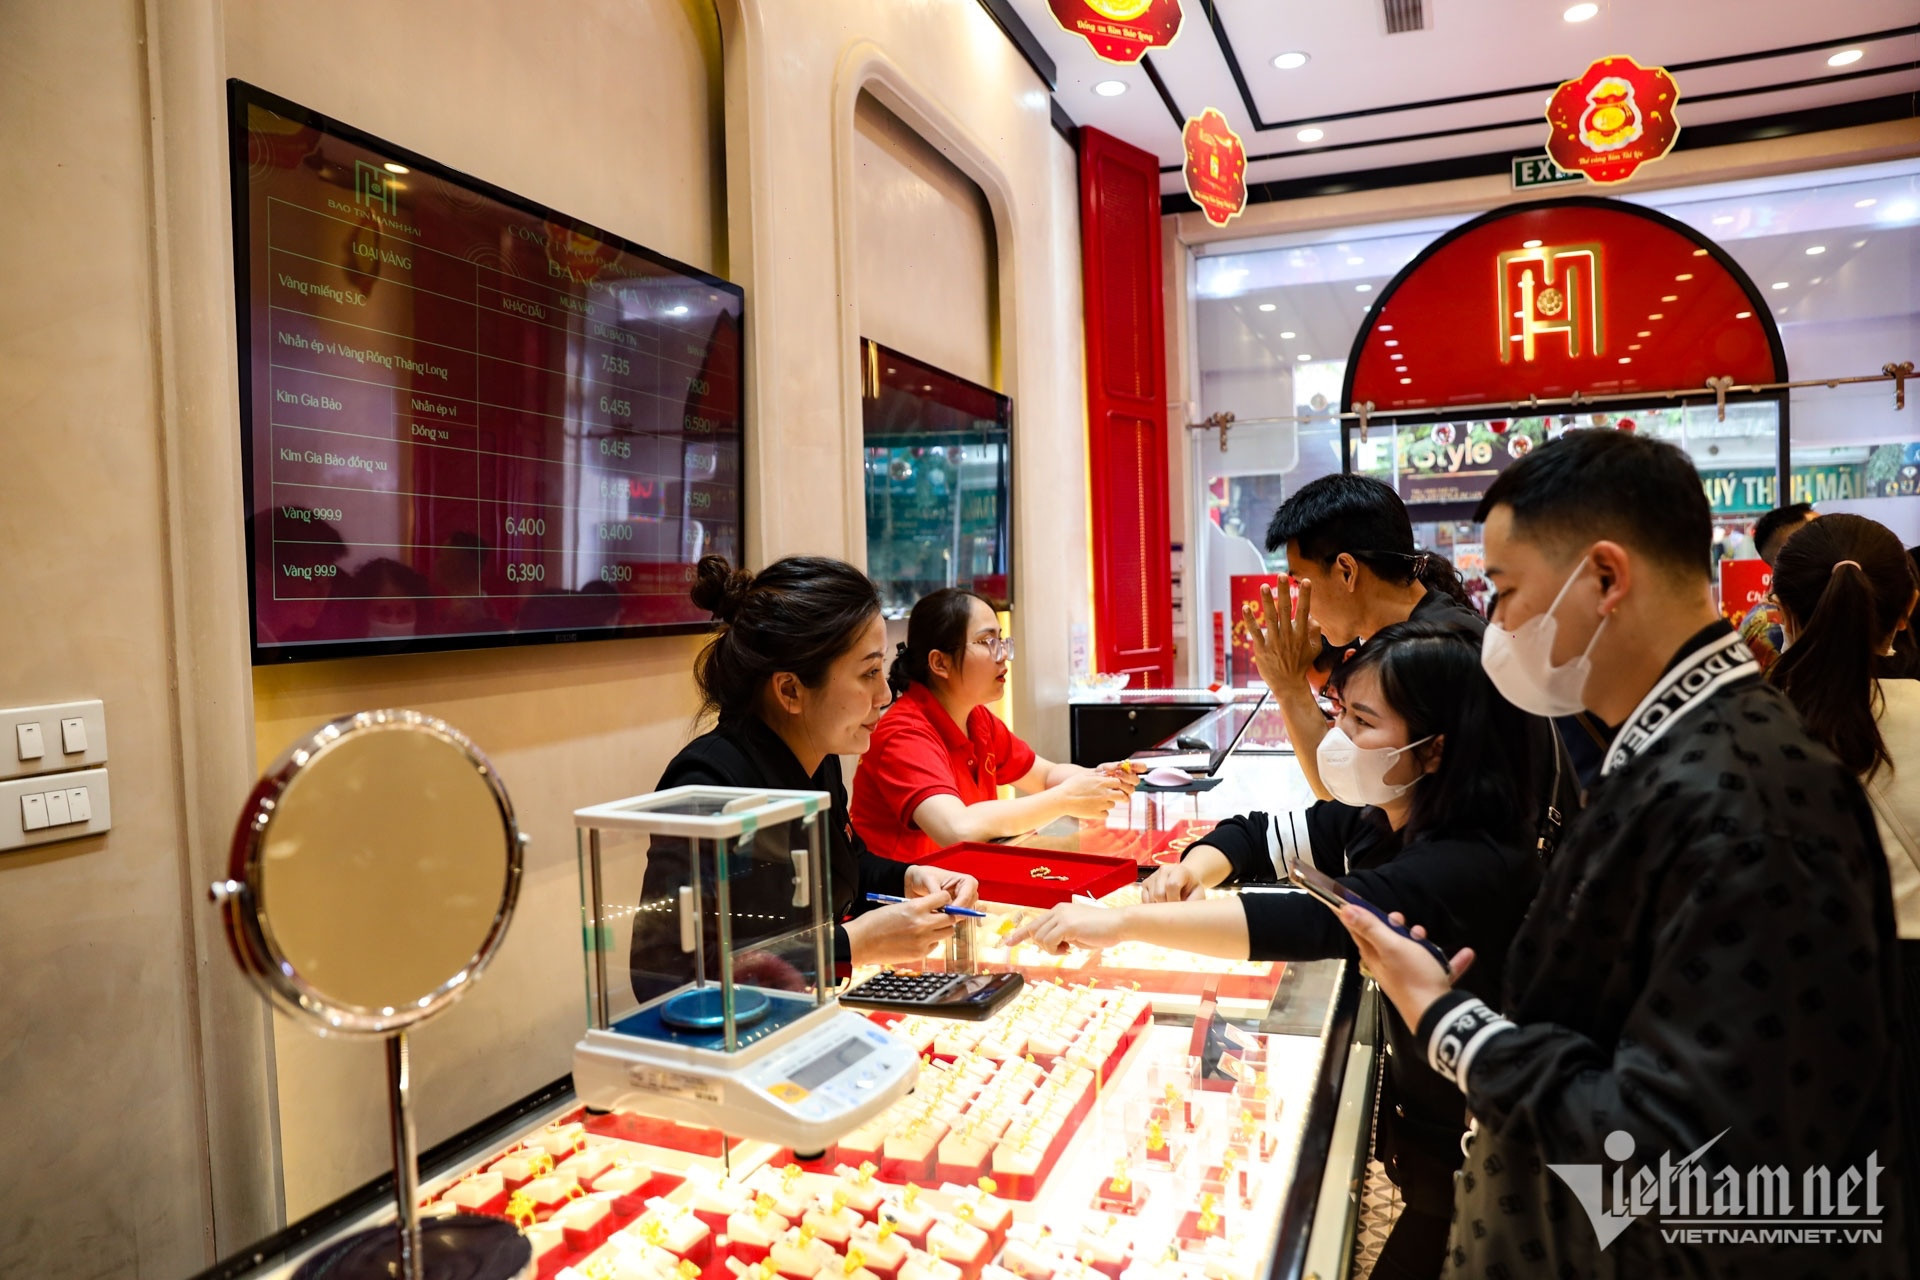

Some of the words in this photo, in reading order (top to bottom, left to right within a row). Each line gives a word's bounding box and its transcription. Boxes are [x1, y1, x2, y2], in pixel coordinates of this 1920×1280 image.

[379, 248, 413, 270] VÀNG
[278, 273, 308, 296] Vàng
[345, 291, 368, 308] SJC
[310, 336, 325, 355] ép
[337, 343, 365, 365] Vàng
[425, 361, 449, 380] Long
[601, 354, 630, 376] 7,535
[276, 388, 298, 405] Kim
[300, 393, 319, 408] Gia
[320, 396, 343, 412] Bảo
[436, 403, 448, 418] ép
[600, 396, 631, 418] 6,455
[438, 429, 449, 441] xu
[279, 447, 302, 463] Kim
[304, 450, 323, 465] Gia
[324, 453, 346, 467] Bảo
[374, 460, 388, 472] xu
[600, 439, 631, 459] 6,455
[1702, 472, 1737, 507] UÝ
[281, 505, 311, 524] Vàng
[505, 516, 546, 537] 6,400
[600, 523, 632, 541] 6,400
[283, 563, 312, 581] Vàng
[507, 563, 545, 583] 6,390
[601, 565, 632, 583] 6,390
[1623, 654, 1733, 751] DOLCE
